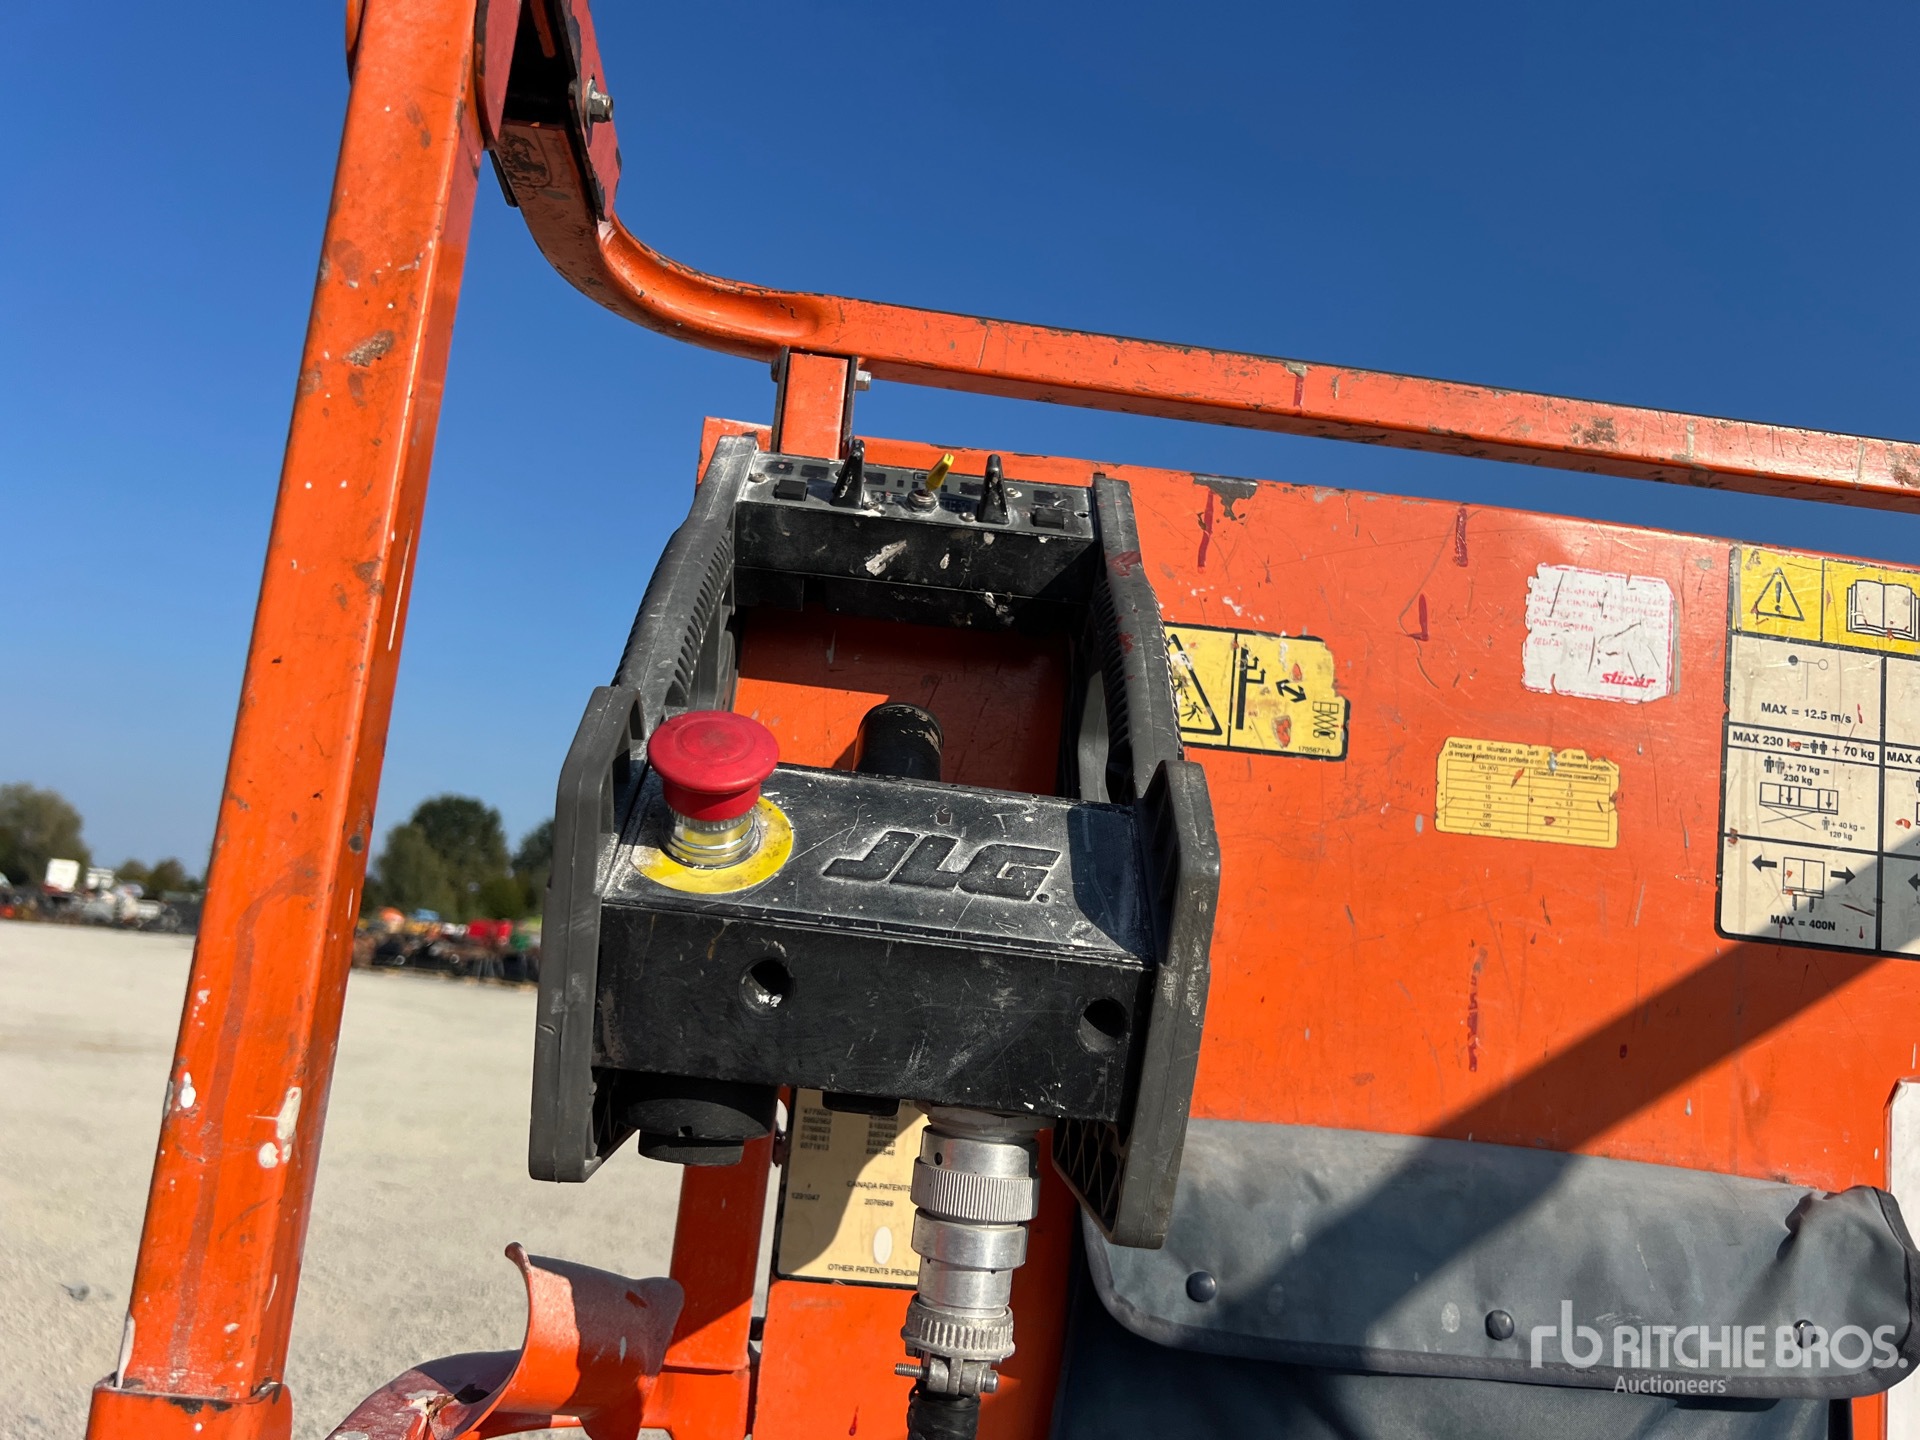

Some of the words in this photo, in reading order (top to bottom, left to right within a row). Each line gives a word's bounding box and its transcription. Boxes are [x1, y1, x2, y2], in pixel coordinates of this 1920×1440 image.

[1761, 702, 1787, 715] MAX
[1804, 709, 1827, 720] 12.5
[1830, 713, 1851, 723] m/s
[1448, 741, 1472, 749] Distanze
[1486, 745, 1511, 753] sicurezza
[1733, 731, 1759, 743] MAX
[1763, 735, 1783, 747] 230
[1844, 746, 1858, 757] 70
[1861, 748, 1875, 761] kg
[1887, 751, 1912, 764] MAX
[1796, 764, 1807, 772] 70
[1809, 765, 1820, 775] kg
[1783, 773, 1799, 782] 230
[1802, 775, 1812, 786] kg
[1849, 823, 1858, 831] kg
[1843, 832, 1852, 841] kg
[822, 830, 1062, 902] JLG
[1770, 915, 1795, 926] MAX
[1809, 919, 1836, 931] 400N
[846, 1180, 877, 1190] CANADA
[879, 1182, 911, 1192] PATENTS
[828, 1263, 854, 1272] OTHER
[856, 1264, 889, 1275] PATENTS
[891, 1267, 919, 1277] PENDIN
